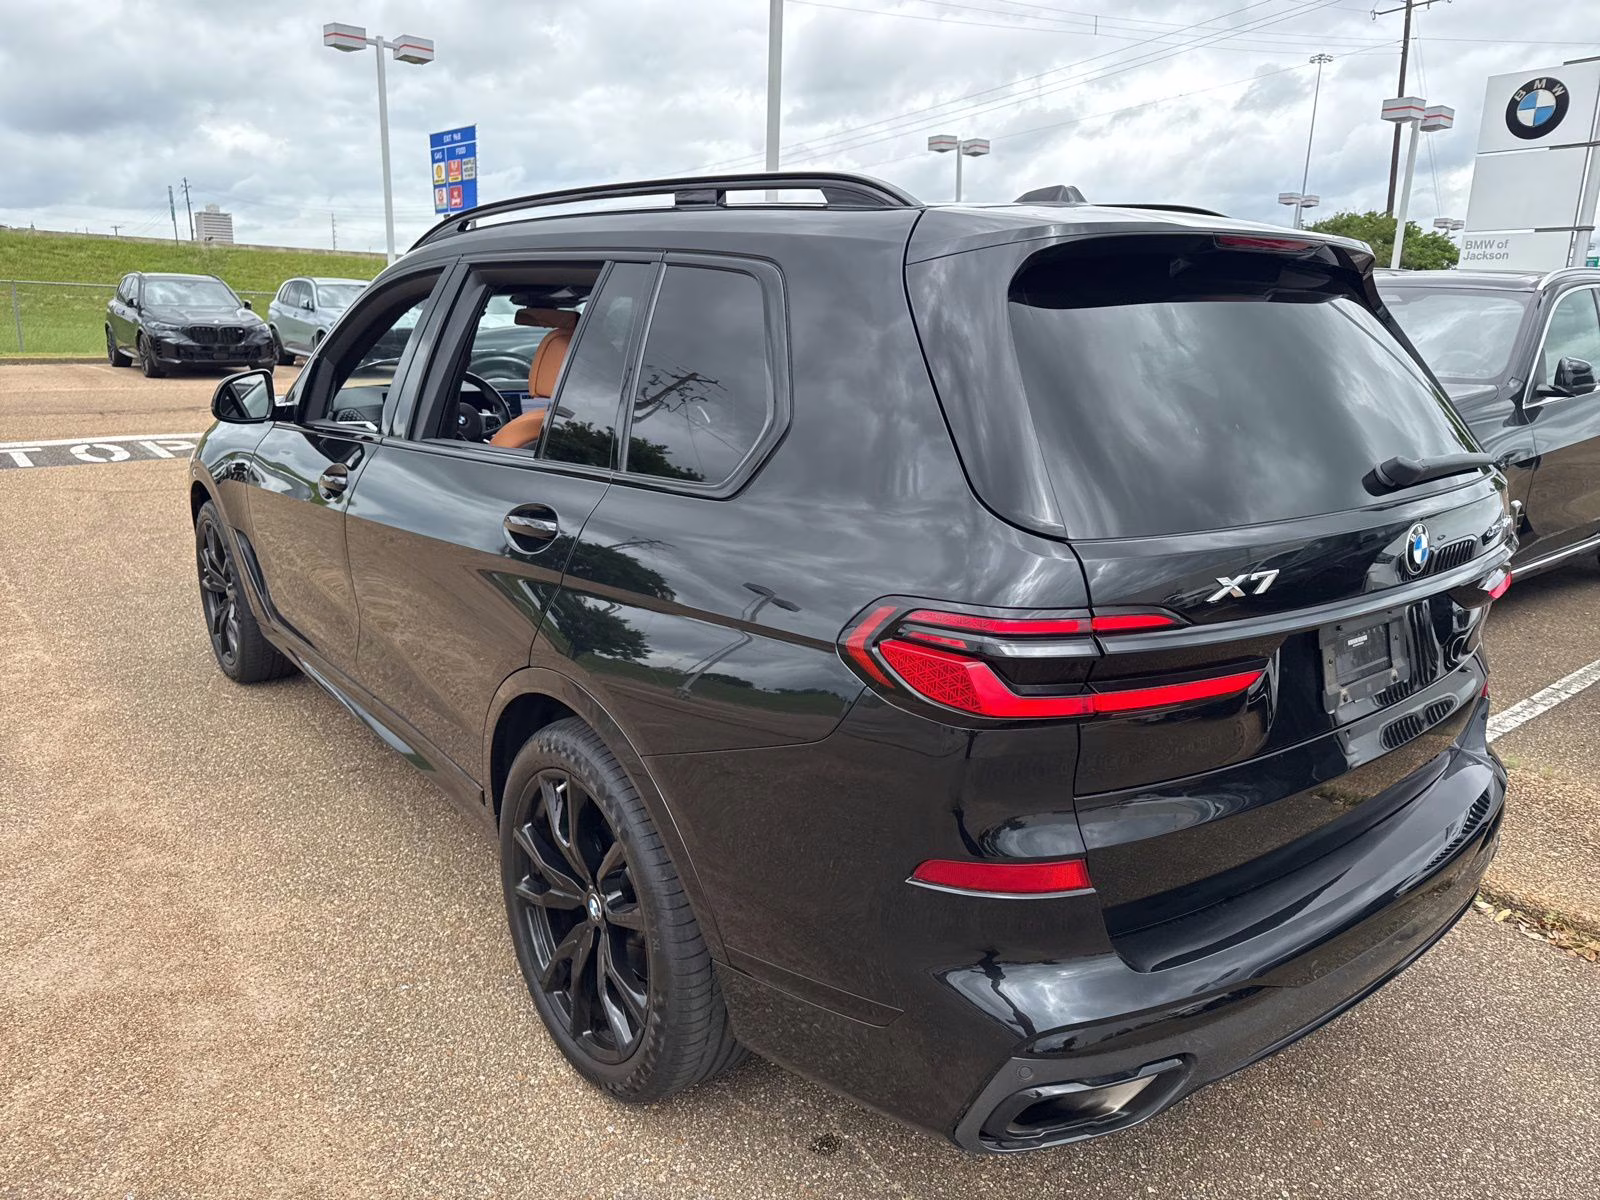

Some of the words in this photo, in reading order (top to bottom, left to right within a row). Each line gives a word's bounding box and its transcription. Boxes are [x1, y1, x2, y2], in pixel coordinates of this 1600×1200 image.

[1514, 79, 1565, 101] BMW
[1465, 239, 1495, 250] BMW
[1497, 239, 1509, 249] of
[1463, 250, 1509, 260] Jackson
[1204, 568, 1280, 603] X7
